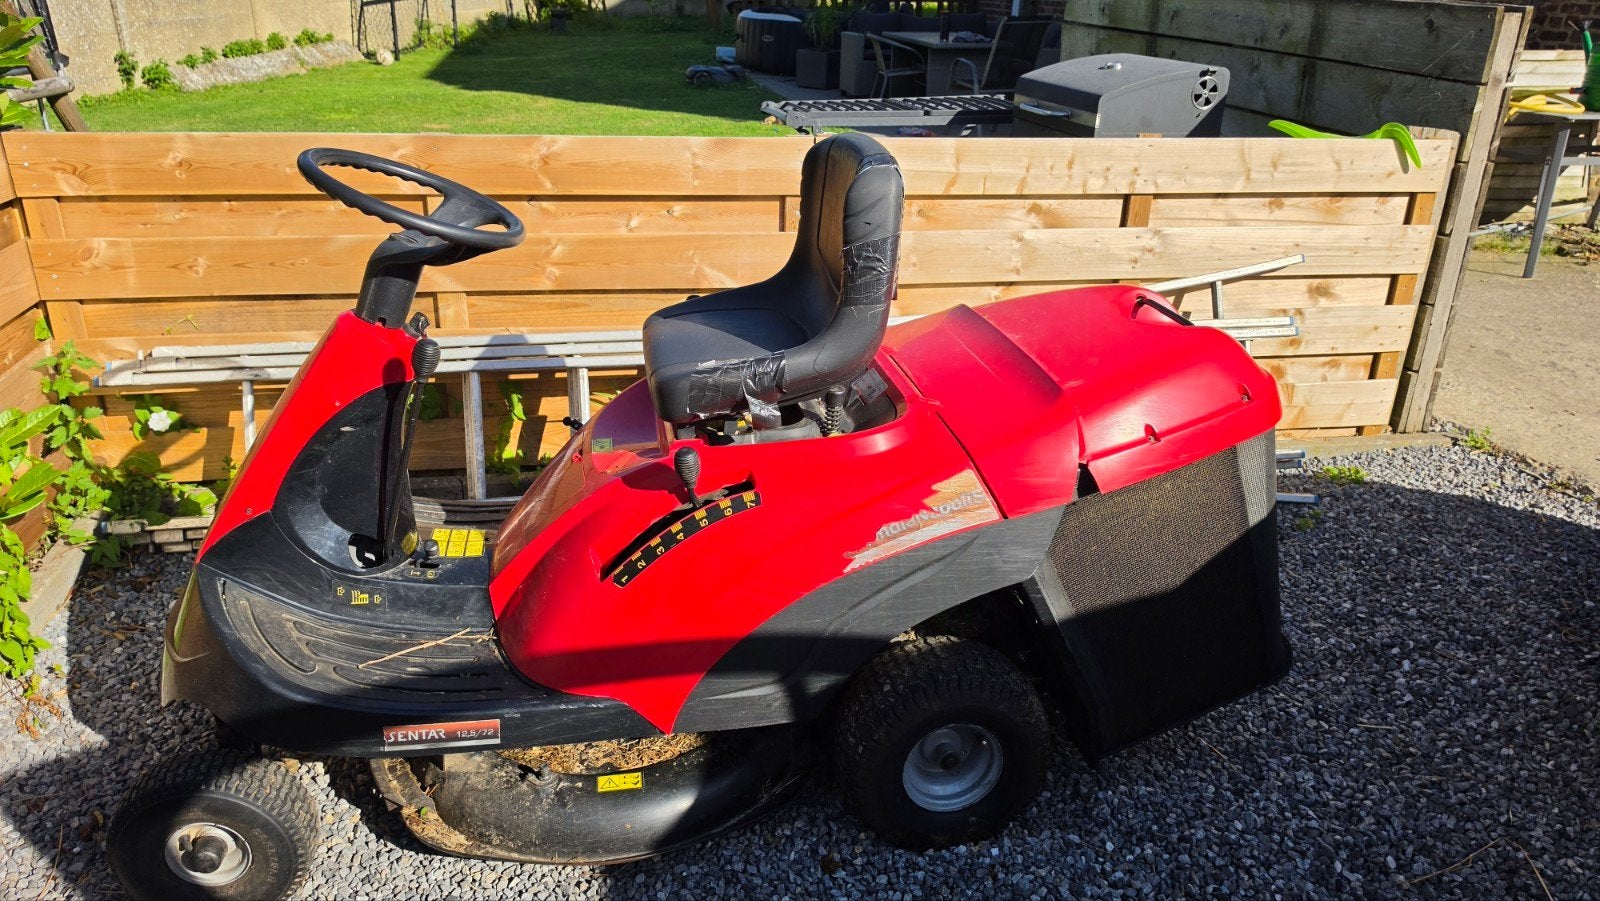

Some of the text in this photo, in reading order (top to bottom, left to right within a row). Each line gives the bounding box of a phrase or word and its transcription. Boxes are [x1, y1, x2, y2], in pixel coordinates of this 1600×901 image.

[621, 501, 756, 583] 1 2 3 4 5 6 7
[387, 728, 446, 742] SENTAR
